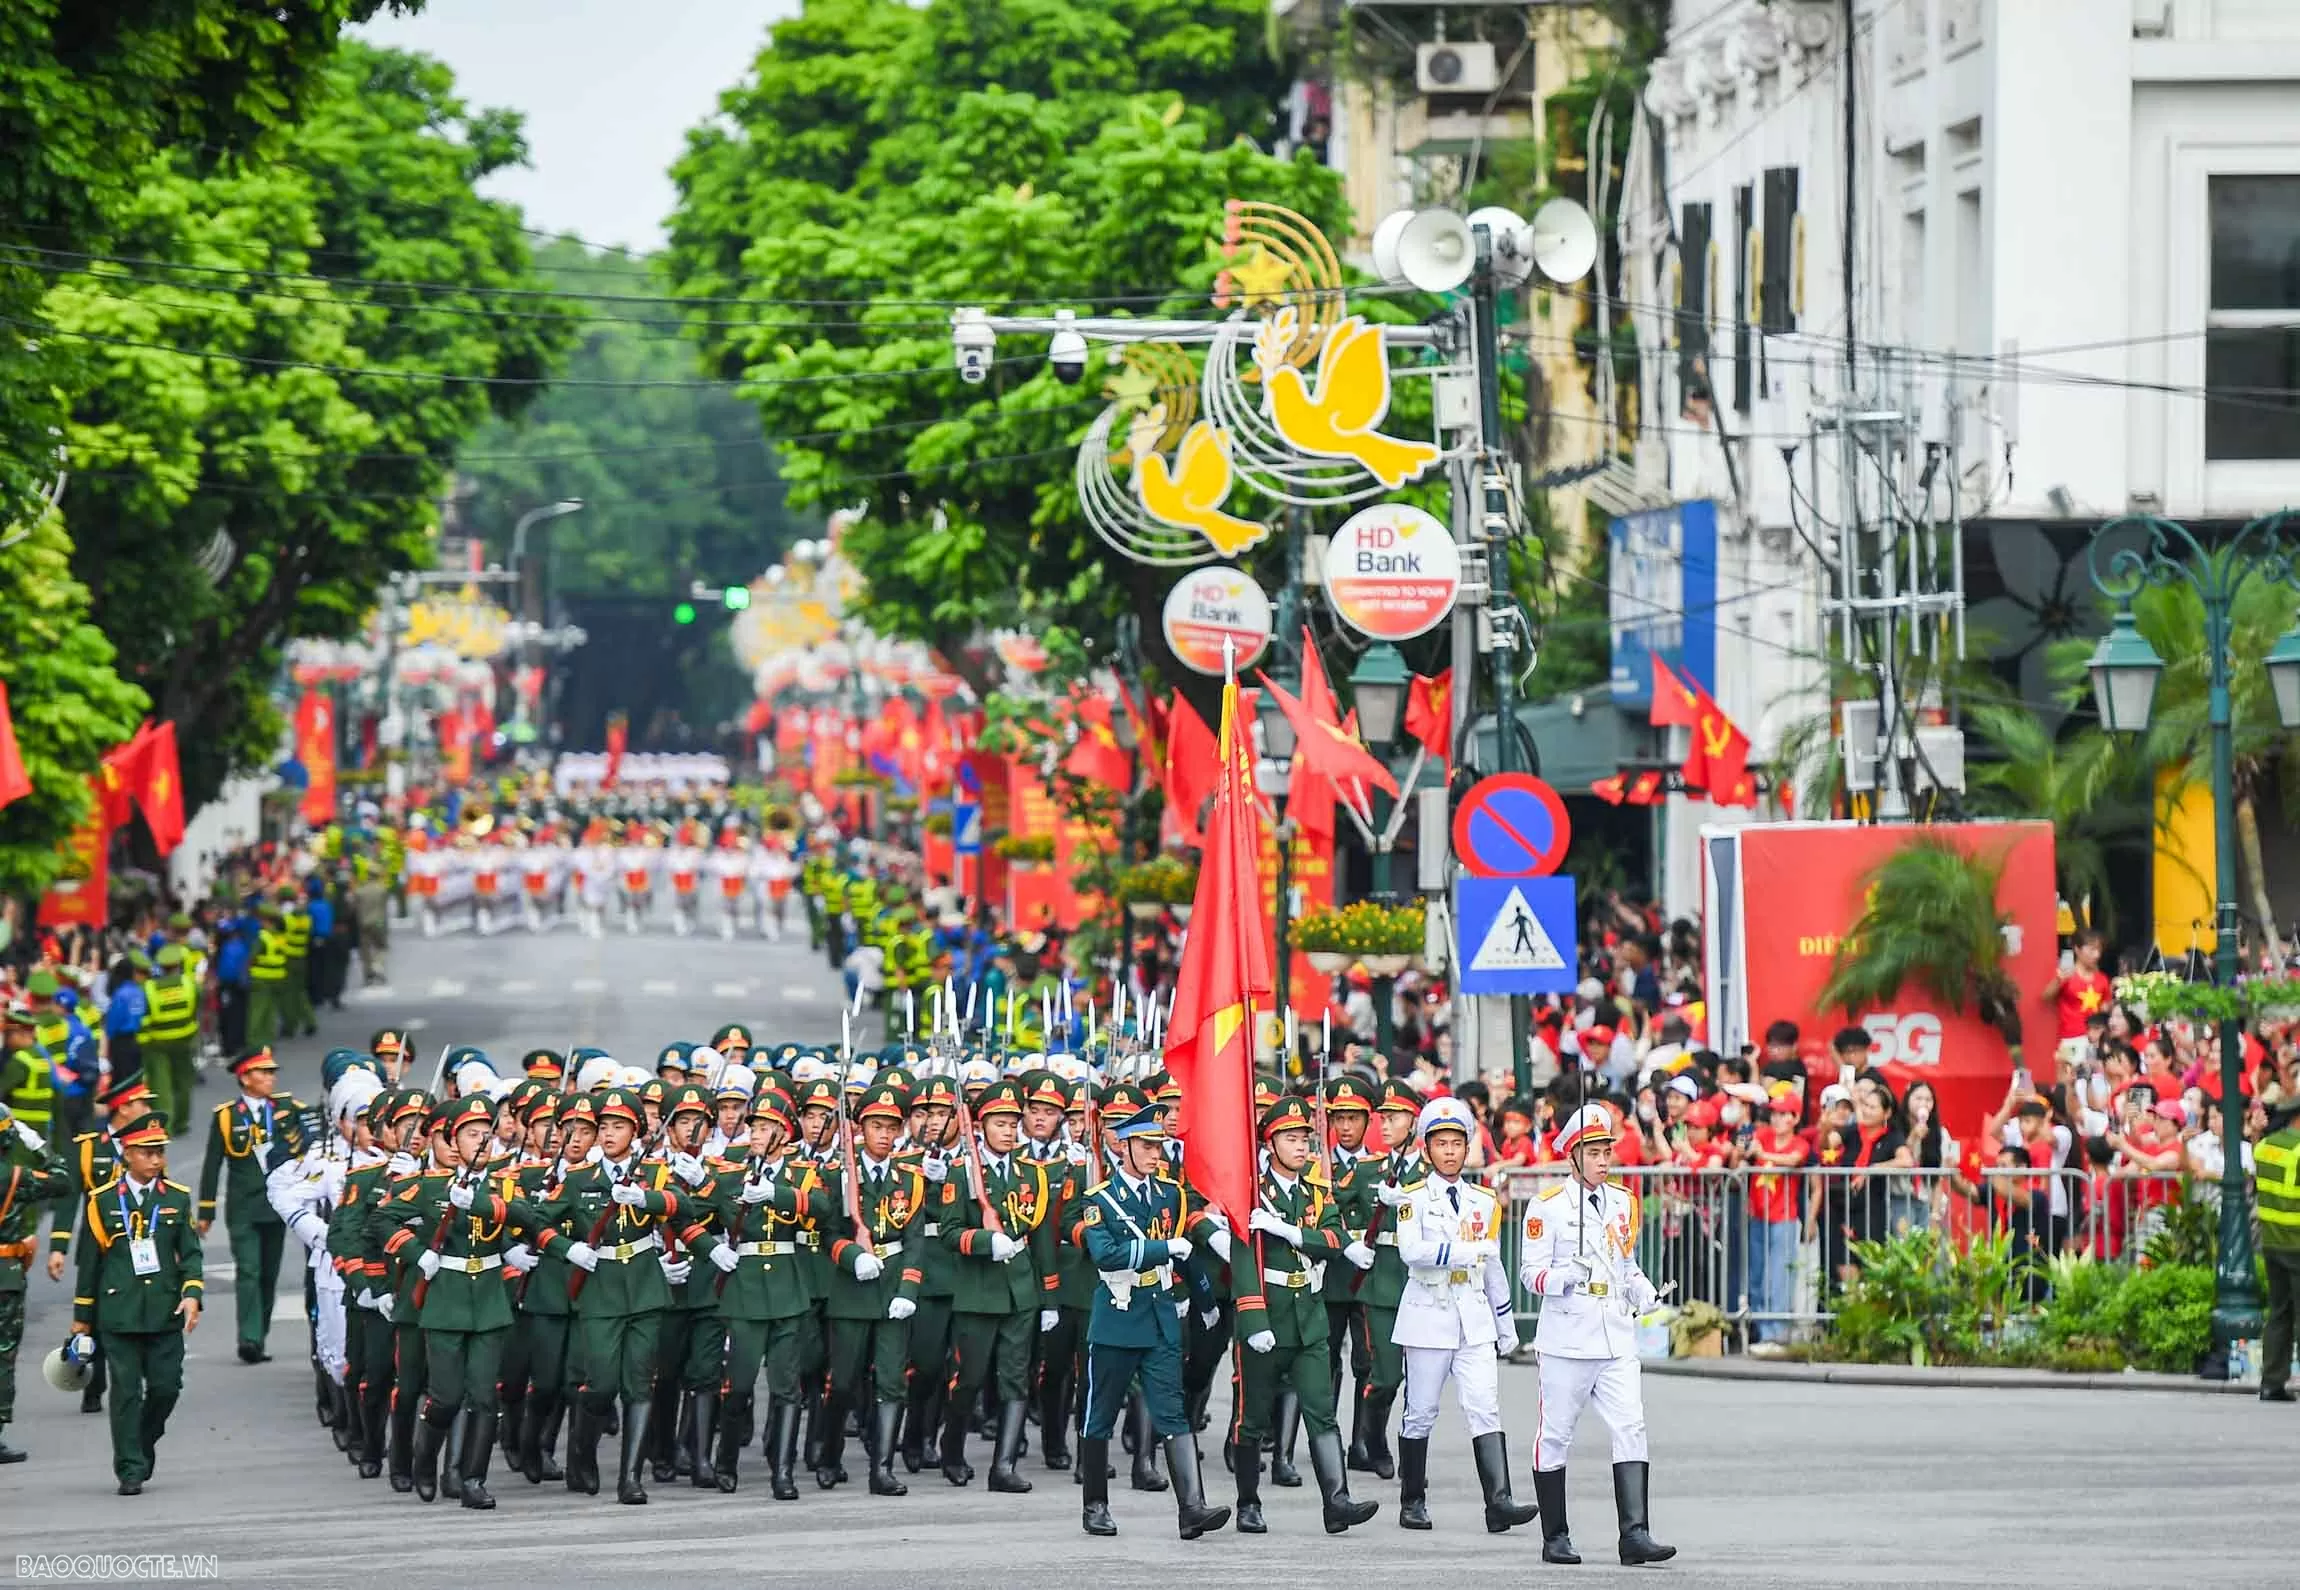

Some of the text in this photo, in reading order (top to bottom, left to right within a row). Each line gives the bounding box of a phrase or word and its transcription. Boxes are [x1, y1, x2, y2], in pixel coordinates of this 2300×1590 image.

[1356, 526, 1395, 548] HD
[1357, 551, 1421, 573] Bank
[1862, 1012, 1942, 1067] 5G
